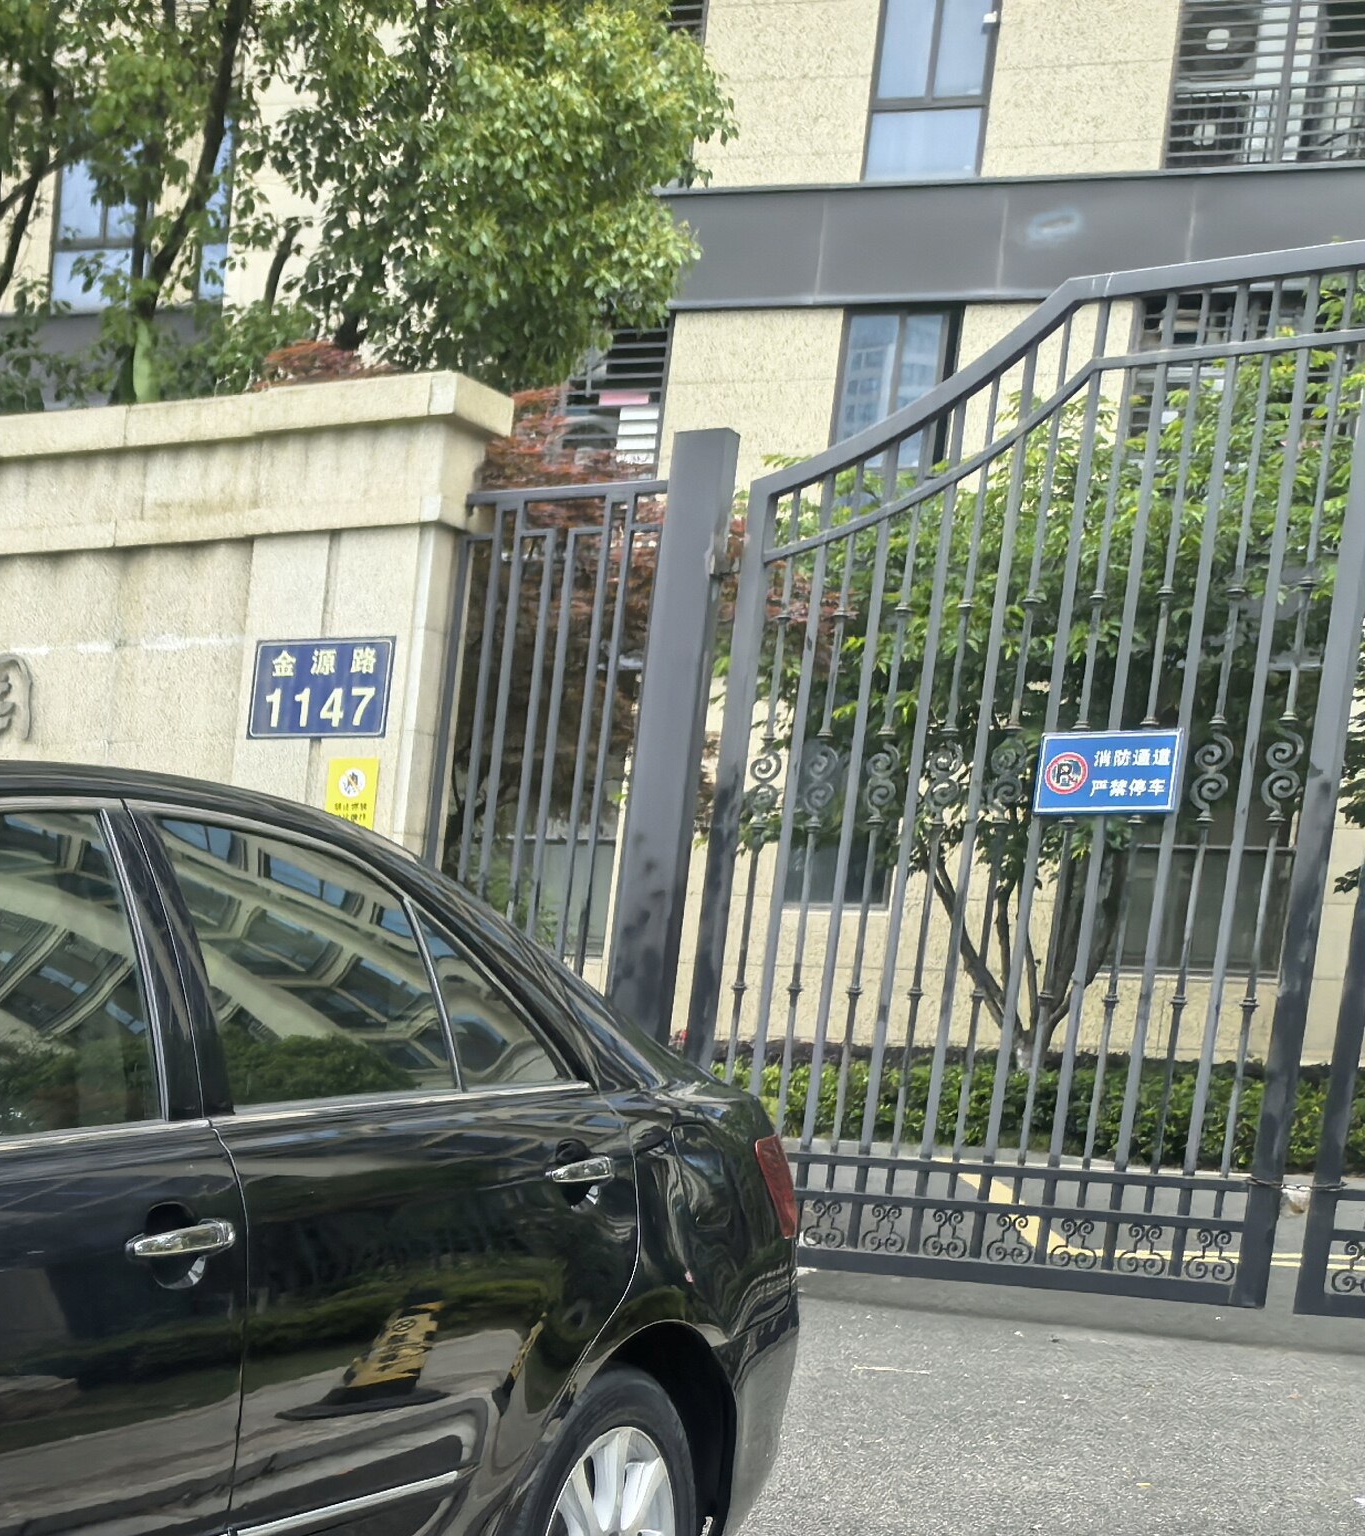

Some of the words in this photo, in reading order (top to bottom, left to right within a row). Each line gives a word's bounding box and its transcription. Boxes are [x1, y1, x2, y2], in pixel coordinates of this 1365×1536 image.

[271, 647, 376, 677] 金源路
[266, 687, 376, 728] 1147
[1094, 747, 1171, 767] 消防通道
[1089, 778, 1166, 797] 严禁停车
